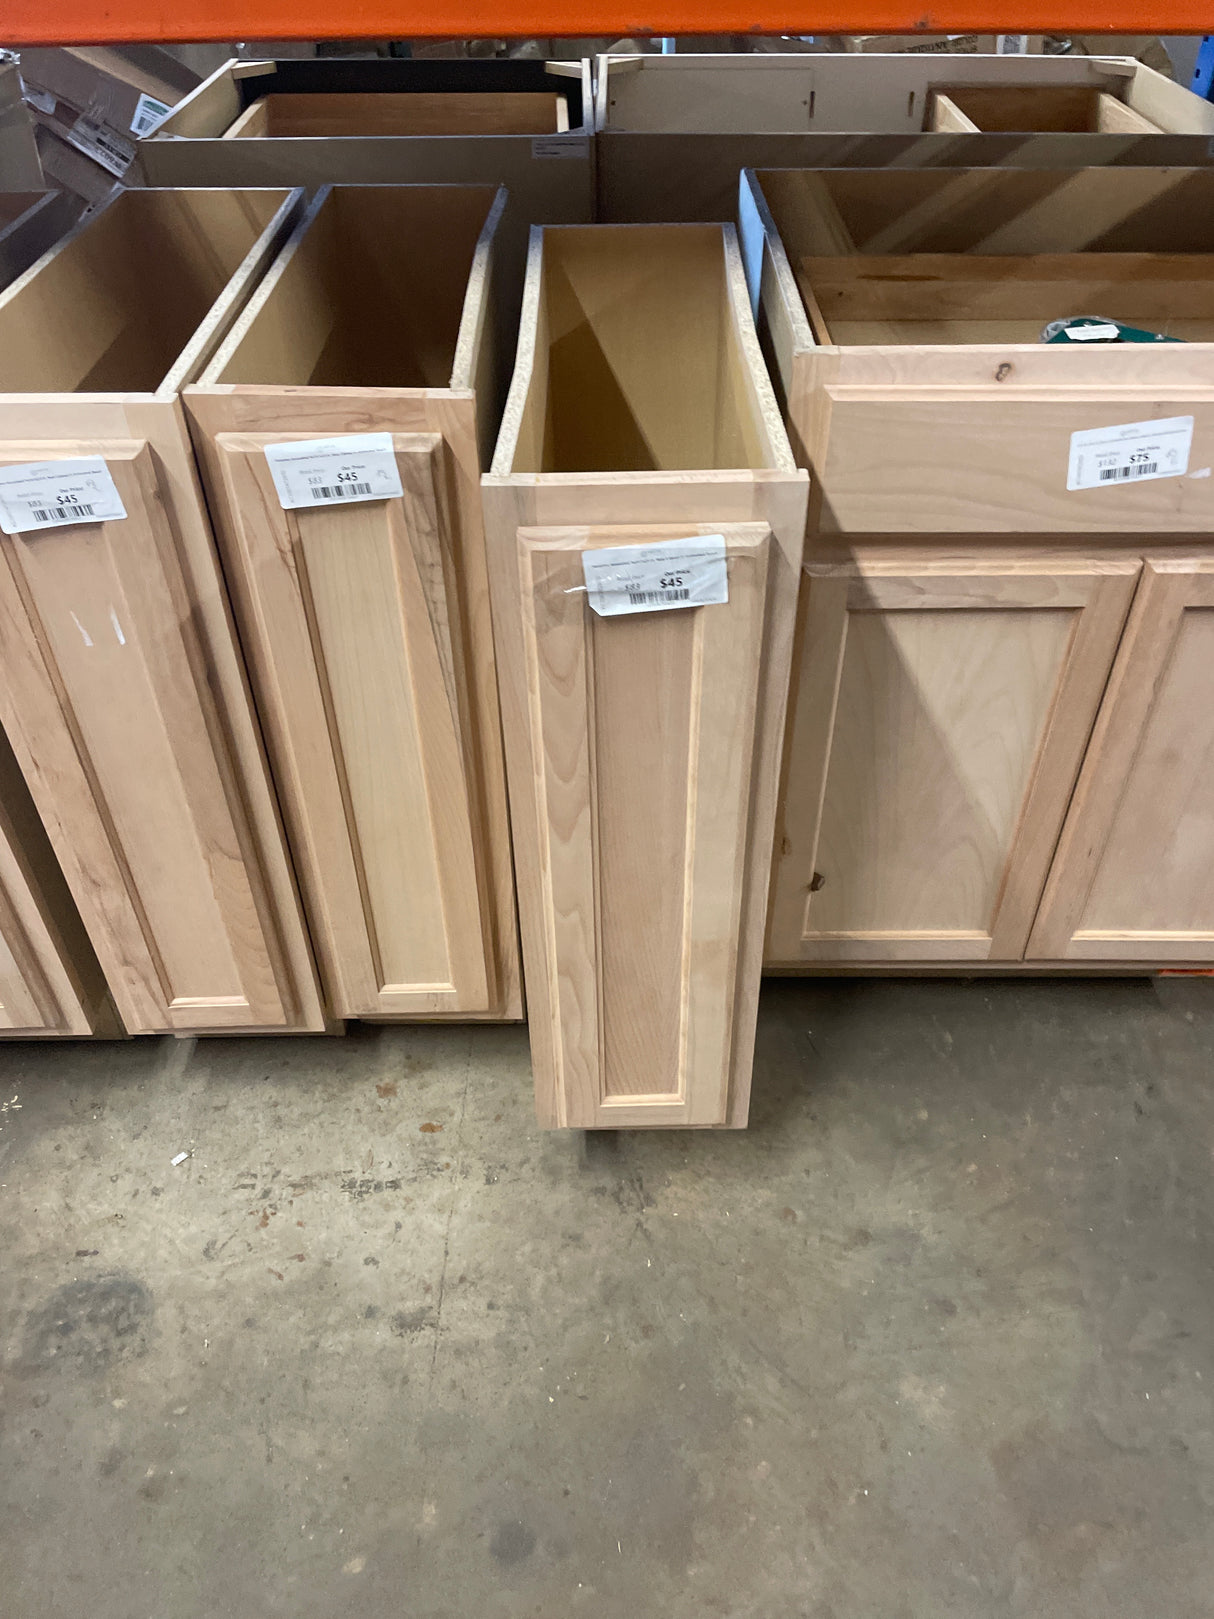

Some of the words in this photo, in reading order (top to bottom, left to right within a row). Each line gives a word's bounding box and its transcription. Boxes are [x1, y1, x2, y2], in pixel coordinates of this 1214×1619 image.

[1129, 452, 1149, 464] $75
[337, 471, 358, 483] $45
[56, 494, 78, 505] $45
[660, 576, 683, 589] $45
